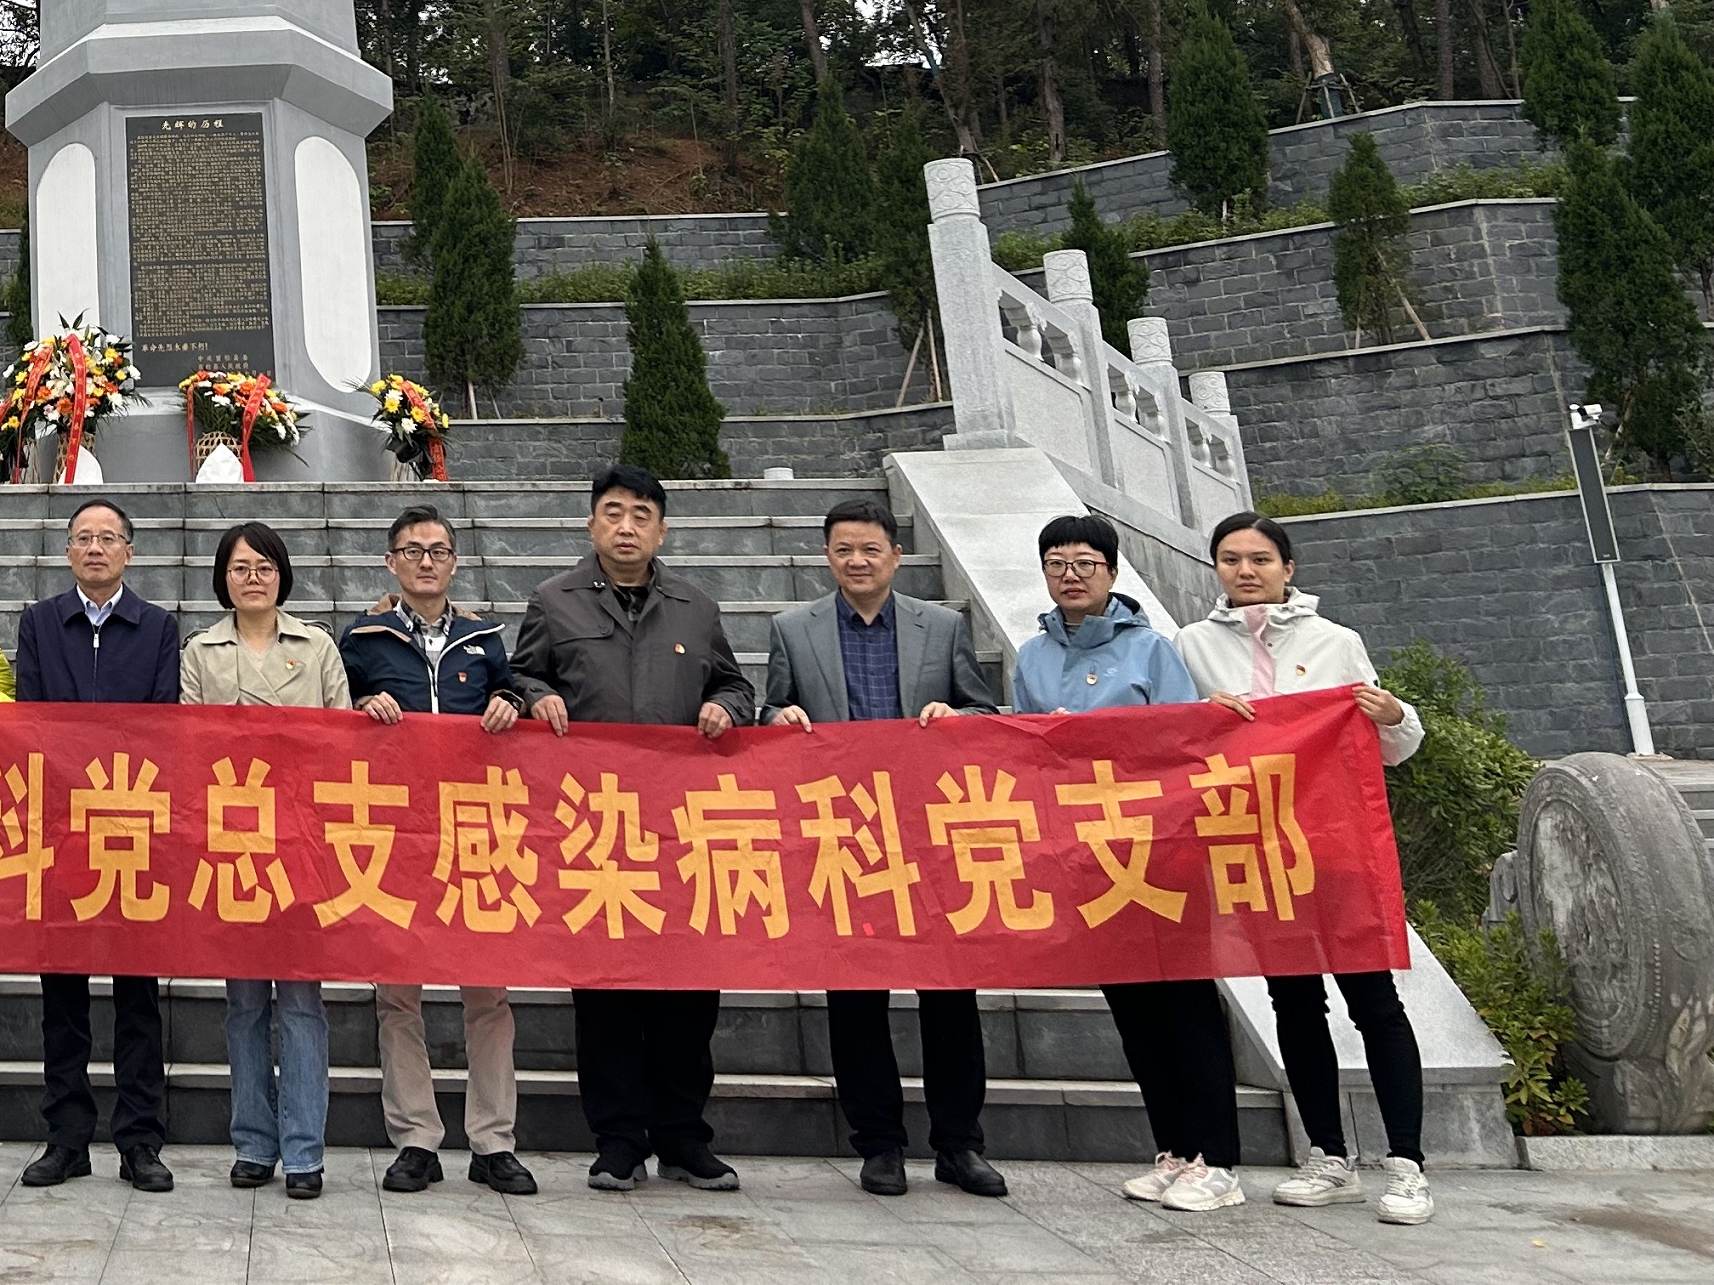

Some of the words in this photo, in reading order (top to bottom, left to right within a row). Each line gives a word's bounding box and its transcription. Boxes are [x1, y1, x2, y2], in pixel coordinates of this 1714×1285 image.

[160, 118, 225, 131] 光辉的历程
